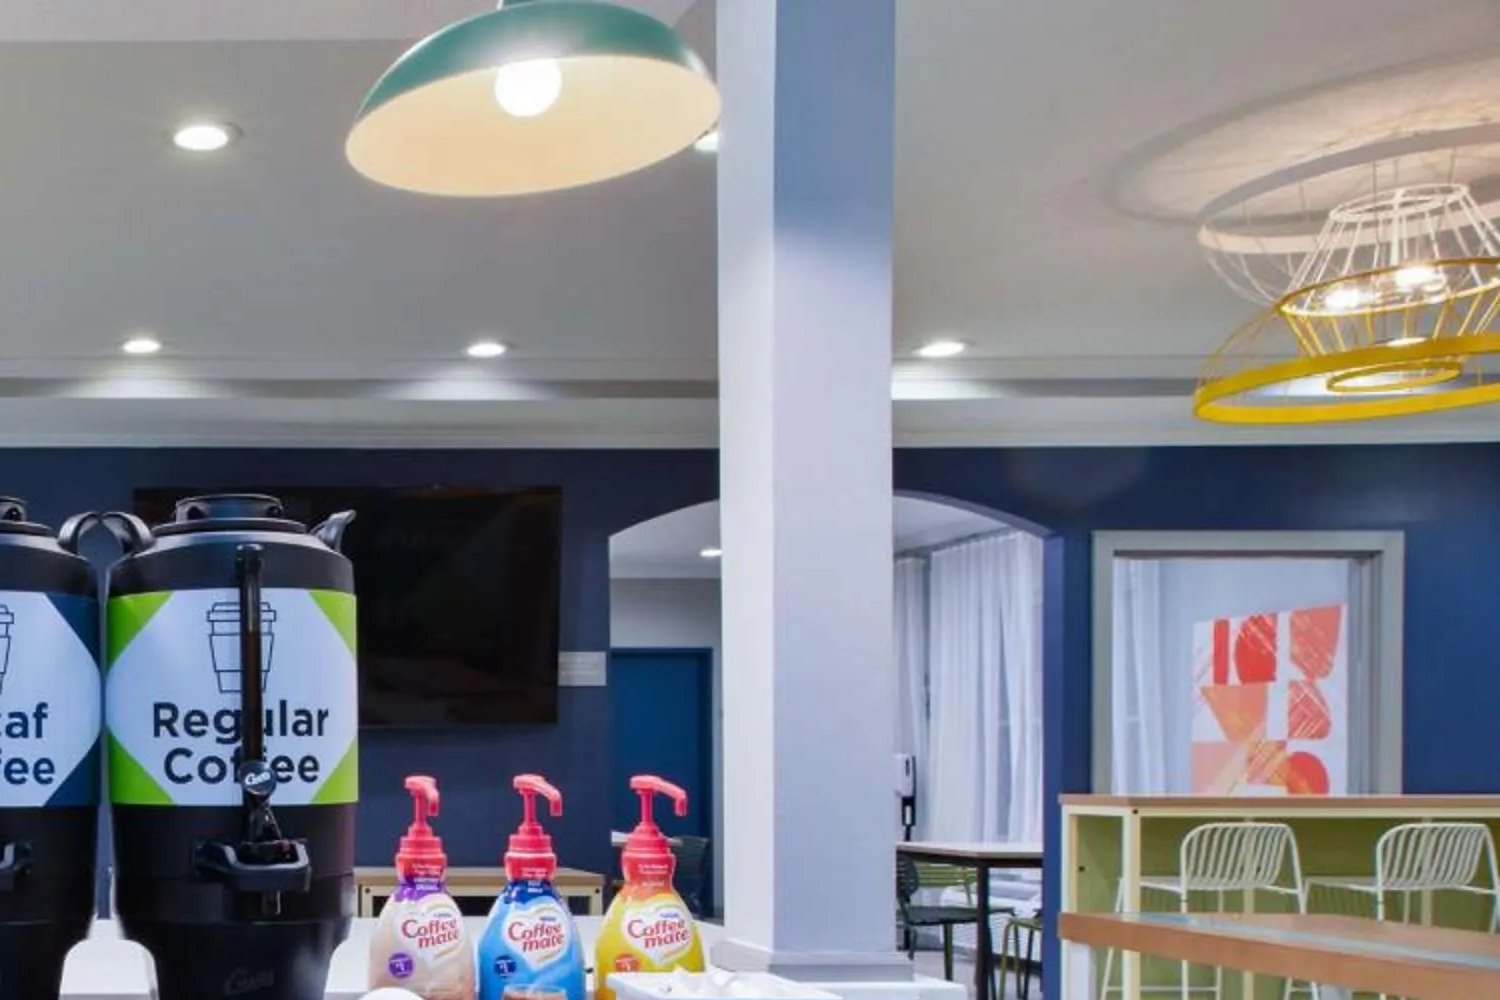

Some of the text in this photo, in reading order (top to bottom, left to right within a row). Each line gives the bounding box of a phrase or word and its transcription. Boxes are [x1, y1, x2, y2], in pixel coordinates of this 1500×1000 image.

[164, 747, 319, 784] Cofee
[401, 918, 458, 938] Coffee
[508, 921, 563, 941] Coffee
[627, 918, 686, 938] Coffee
[644, 928, 689, 948] mate
[418, 930, 460, 948] mate
[522, 933, 565, 952] mate
